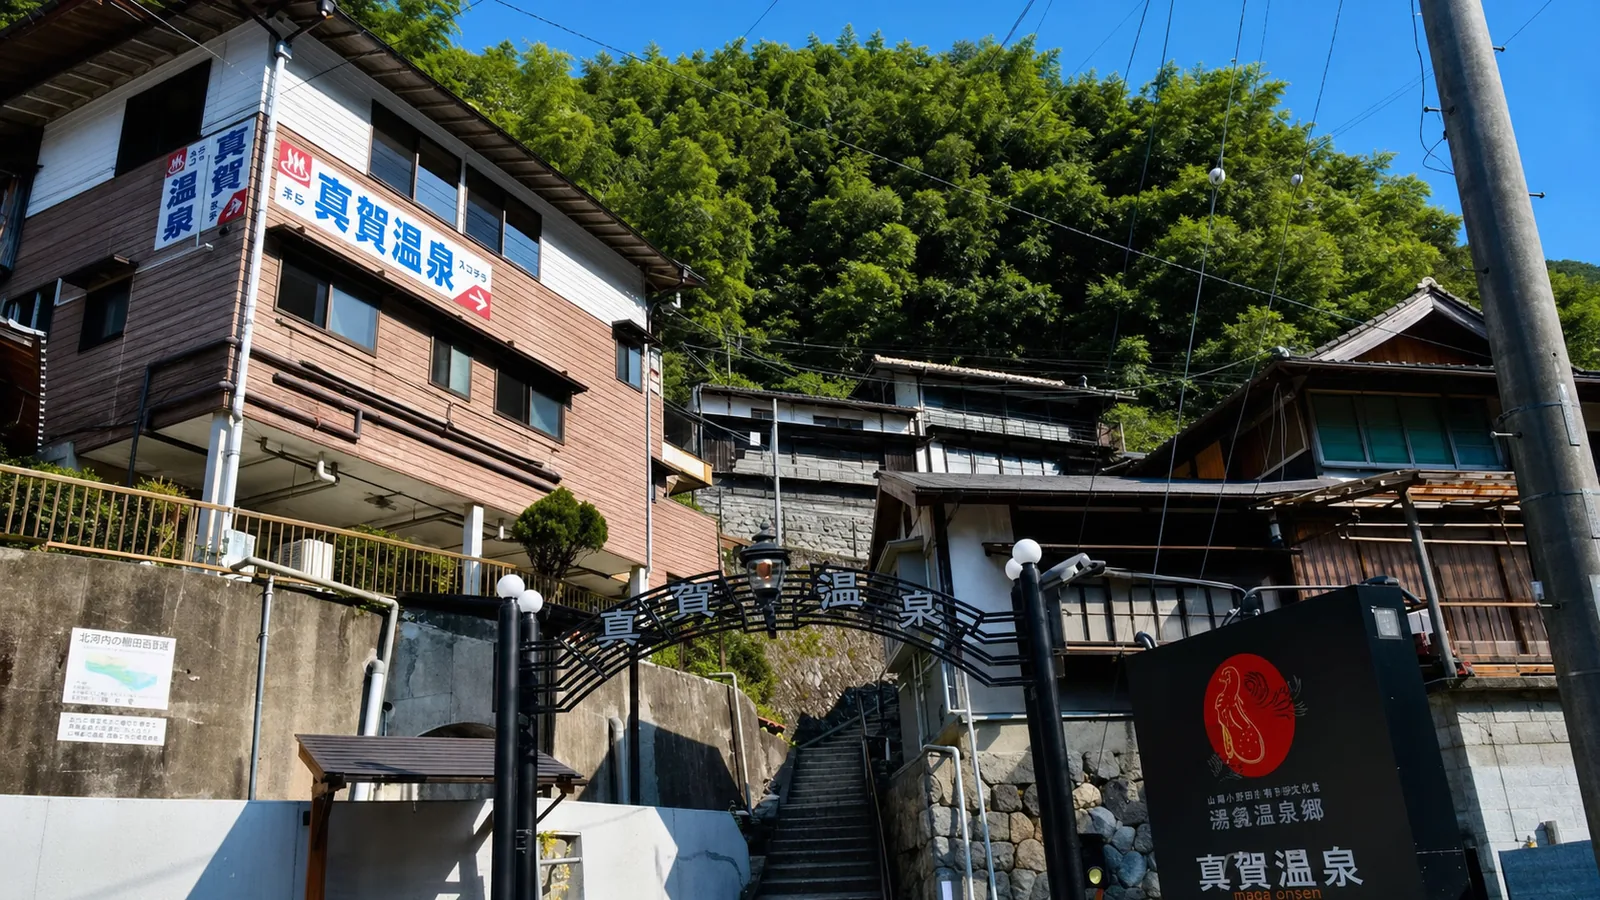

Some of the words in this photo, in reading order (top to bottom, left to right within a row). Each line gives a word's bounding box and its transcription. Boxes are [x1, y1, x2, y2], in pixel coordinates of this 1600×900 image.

[211, 126, 248, 199] 真賀
[163, 170, 198, 242] 温泉
[314, 171, 454, 292] 真賀温泉
[599, 572, 944, 649] 真賀温泉
[1196, 846, 1363, 892] 真賀温泉
[1276, 888, 1321, 900] onsen
